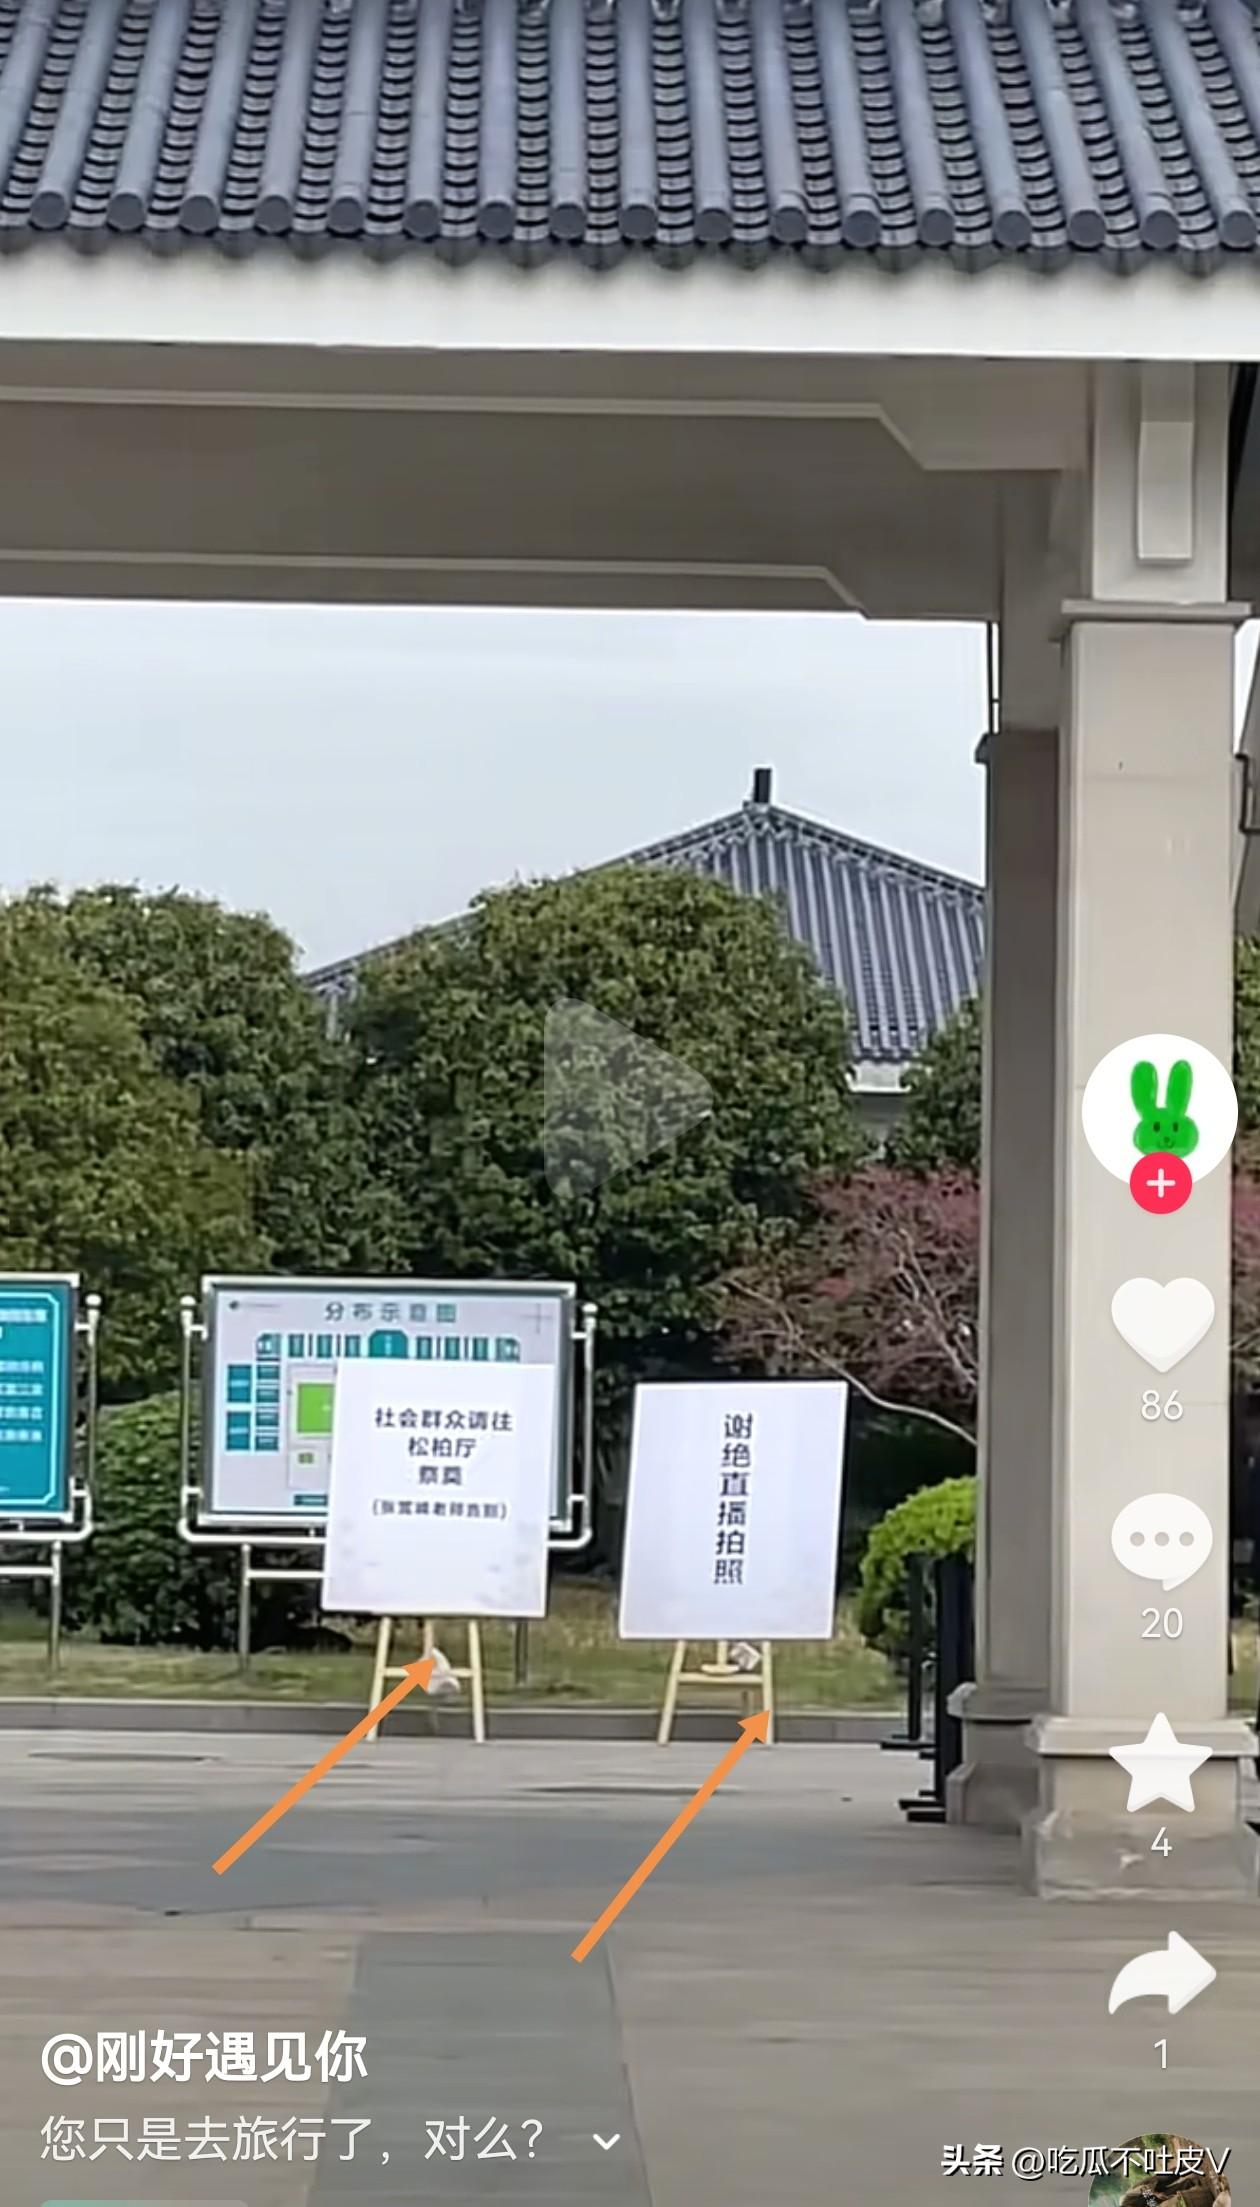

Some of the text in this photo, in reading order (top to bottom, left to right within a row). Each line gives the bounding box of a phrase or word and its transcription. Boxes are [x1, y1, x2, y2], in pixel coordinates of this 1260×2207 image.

[325, 1301, 457, 1323] 分布示意图
[407, 1436, 476, 1458] 松柏厅
[713, 1413, 753, 1585] 谢绝直播拍照
